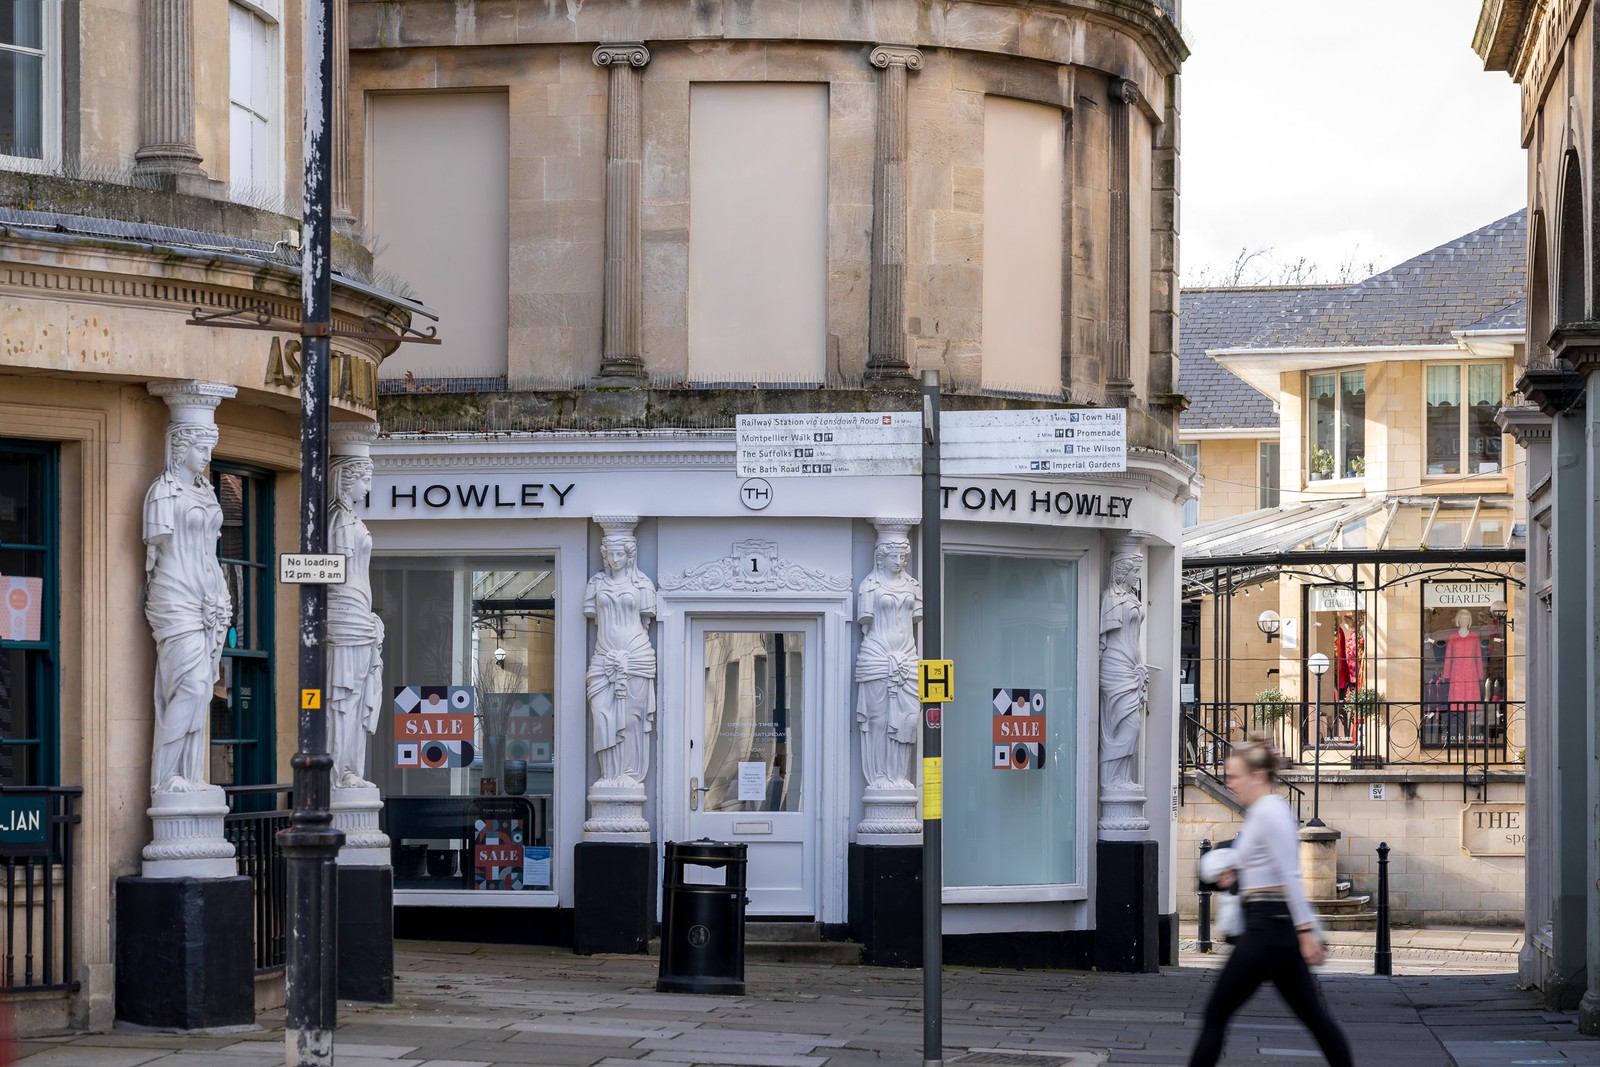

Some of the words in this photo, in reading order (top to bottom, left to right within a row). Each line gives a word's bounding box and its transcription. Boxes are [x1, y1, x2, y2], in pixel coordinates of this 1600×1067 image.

[741, 418, 772, 427] Railway
[774, 418, 804, 426] Station
[806, 417, 817, 425] via
[819, 416, 858, 425] Lansdown
[859, 416, 880, 425] Road
[1081, 413, 1102, 421] Town
[1105, 412, 1122, 420] Hall
[741, 434, 789, 443] Montpellier
[791, 433, 811, 441] Walk
[1076, 429, 1121, 437] Promenade
[742, 450, 756, 458] The
[759, 449, 792, 458] Suffolks
[1076, 444, 1091, 453] The
[1093, 444, 1121, 452] Wilson
[742, 465, 757, 474] The
[759, 464, 778, 473] Bath
[780, 465, 800, 473] Road
[1052, 461, 1086, 470] Imperial
[1088, 460, 1121, 469] Gardens
[391, 483, 576, 509] HOWLEY
[743, 487, 768, 500] TH
[940, 486, 1016, 512] TOM
[1030, 490, 1132, 519] HOWLEY
[287, 557, 301, 566] No
[304, 557, 339, 568] loading
[750, 558, 759, 573] 1
[284, 570, 295, 579] 12
[296, 572, 311, 580] pm
[319, 570, 325, 579] 8
[1434, 583, 1495, 594] CAROLINE
[1438, 593, 1491, 604] CHARLES
[933, 668, 942, 676] 75
[923, 664, 949, 698] H
[306, 692, 316, 706] 7
[405, 719, 463, 735] SALE
[1000, 721, 1040, 737] SALE
[1473, 811, 1520, 829] THE
[1505, 833, 1526, 845] spe
[479, 850, 518, 861] SALE
